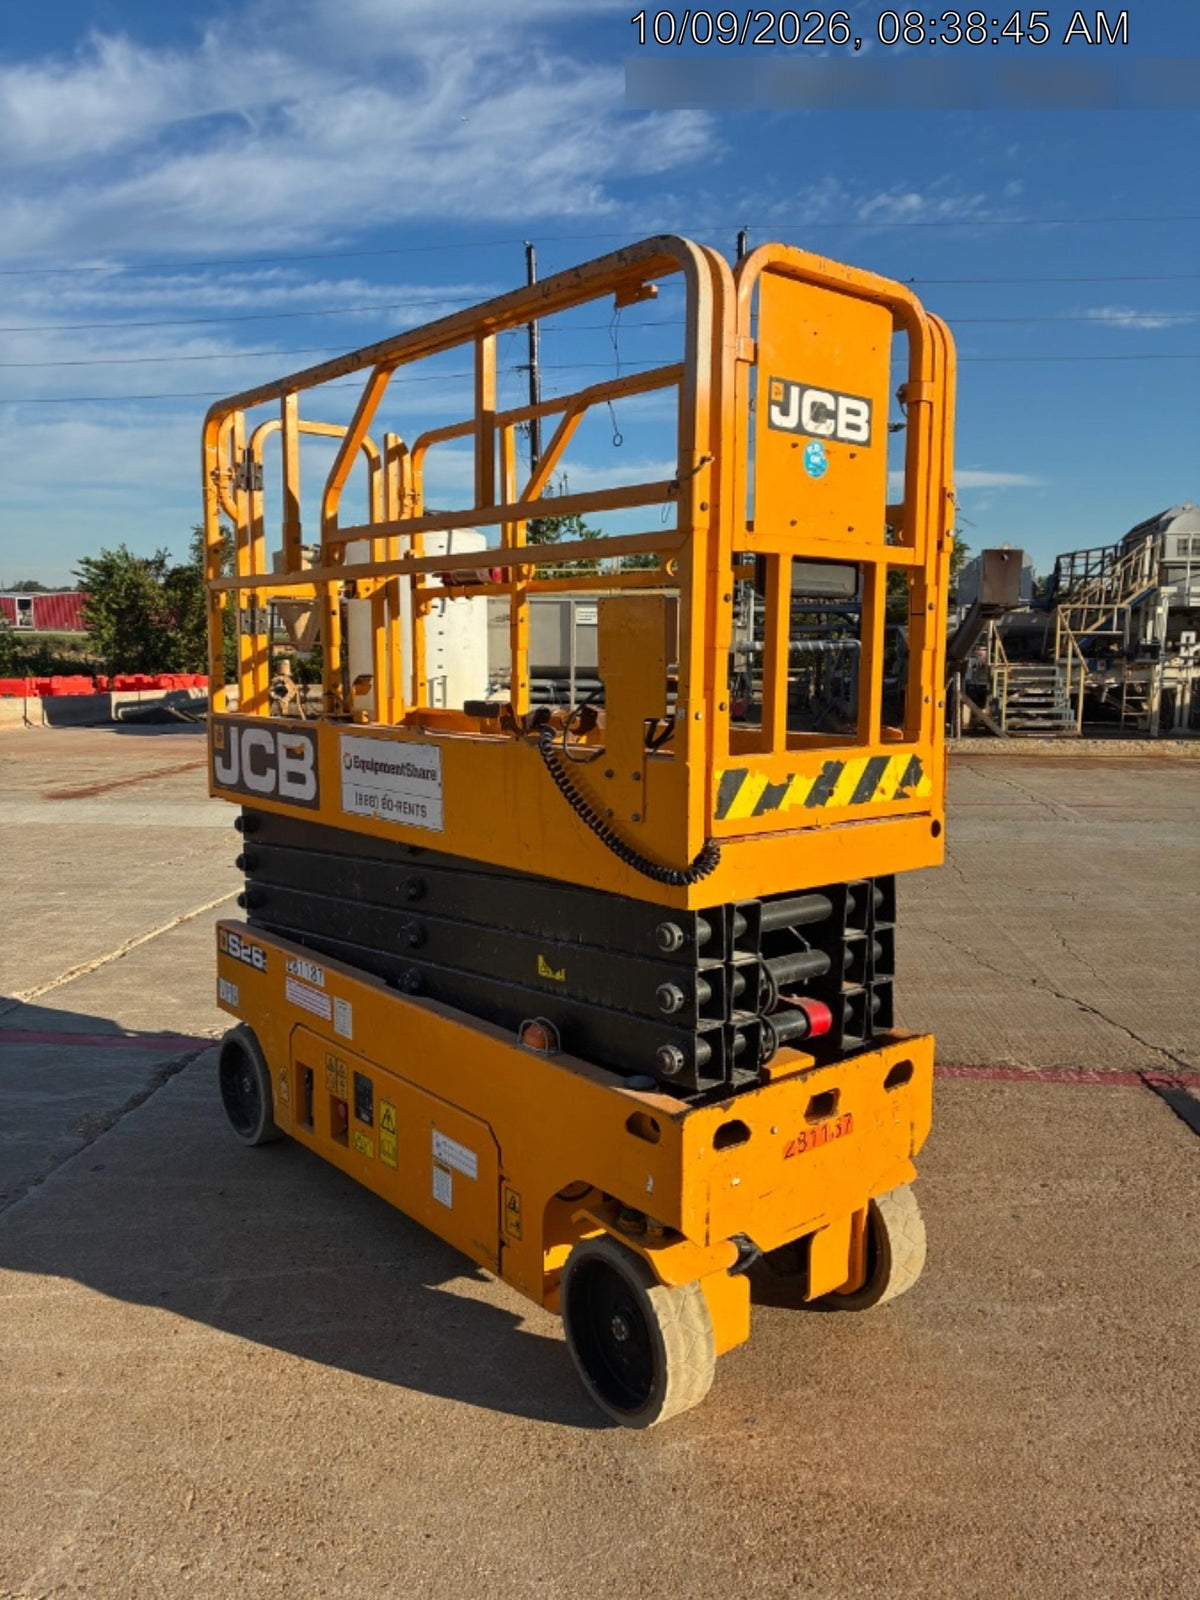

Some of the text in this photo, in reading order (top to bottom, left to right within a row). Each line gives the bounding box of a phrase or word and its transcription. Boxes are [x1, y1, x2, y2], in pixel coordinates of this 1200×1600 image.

[770, 385, 870, 442] JCB
[214, 726, 317, 801] JCB
[352, 755, 437, 781] EquipmentShare
